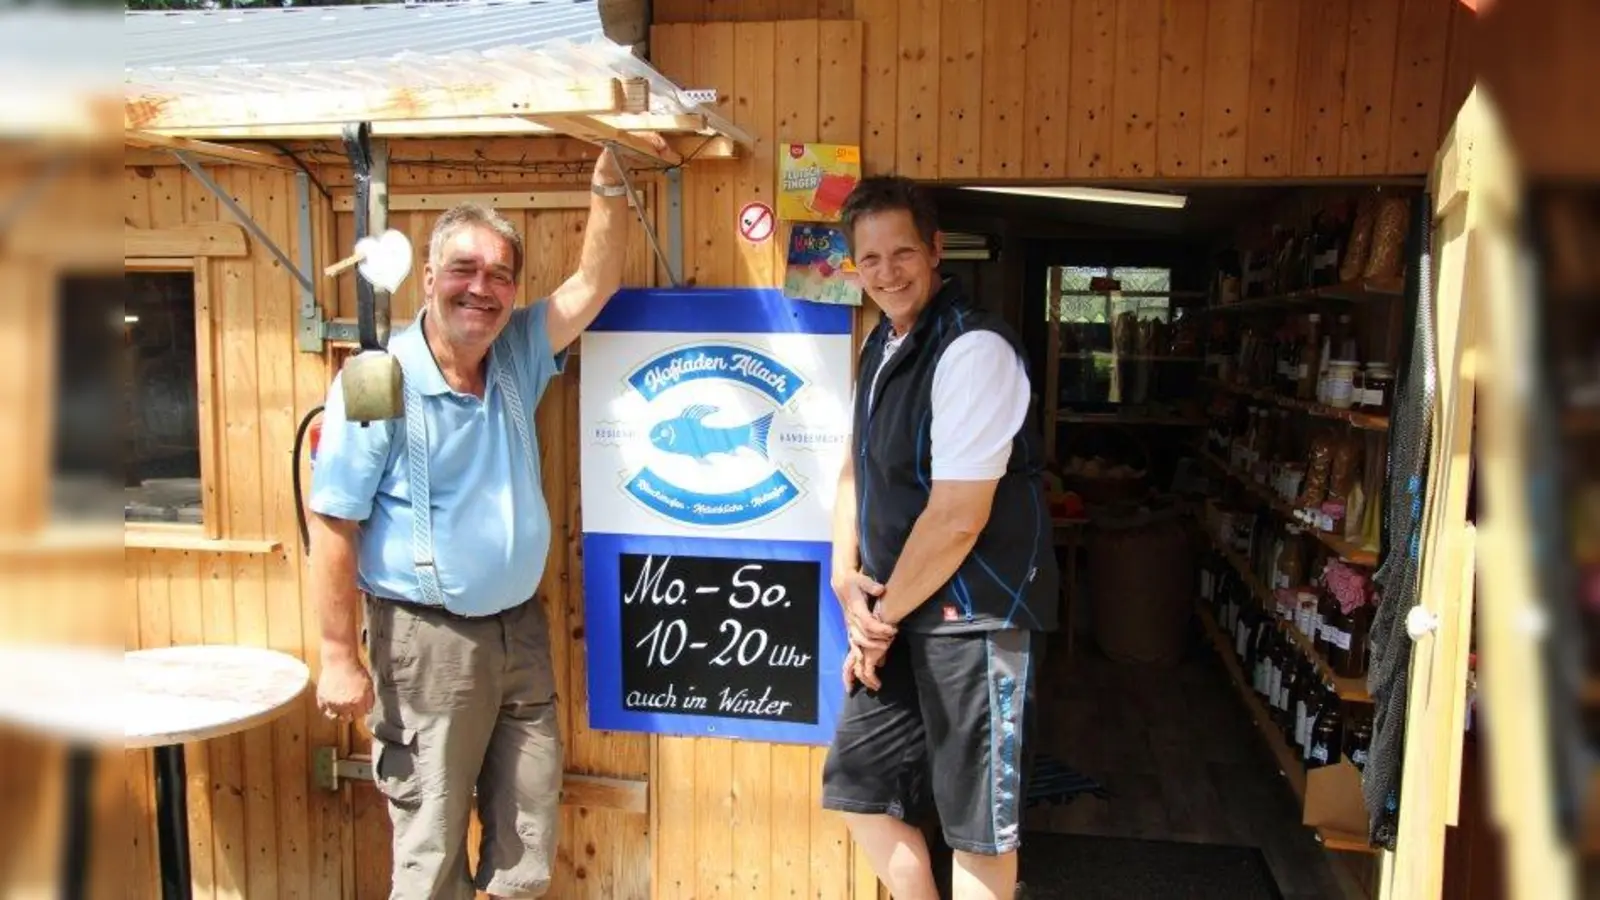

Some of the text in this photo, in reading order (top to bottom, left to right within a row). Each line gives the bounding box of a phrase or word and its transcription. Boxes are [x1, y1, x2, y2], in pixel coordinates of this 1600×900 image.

[644, 353, 787, 393] Hofladen Allach
[624, 554, 688, 606] Mo.
[728, 564, 792, 610] So.
[768, 644, 812, 668] Uhr
[626, 683, 793, 716] auch im Winter
